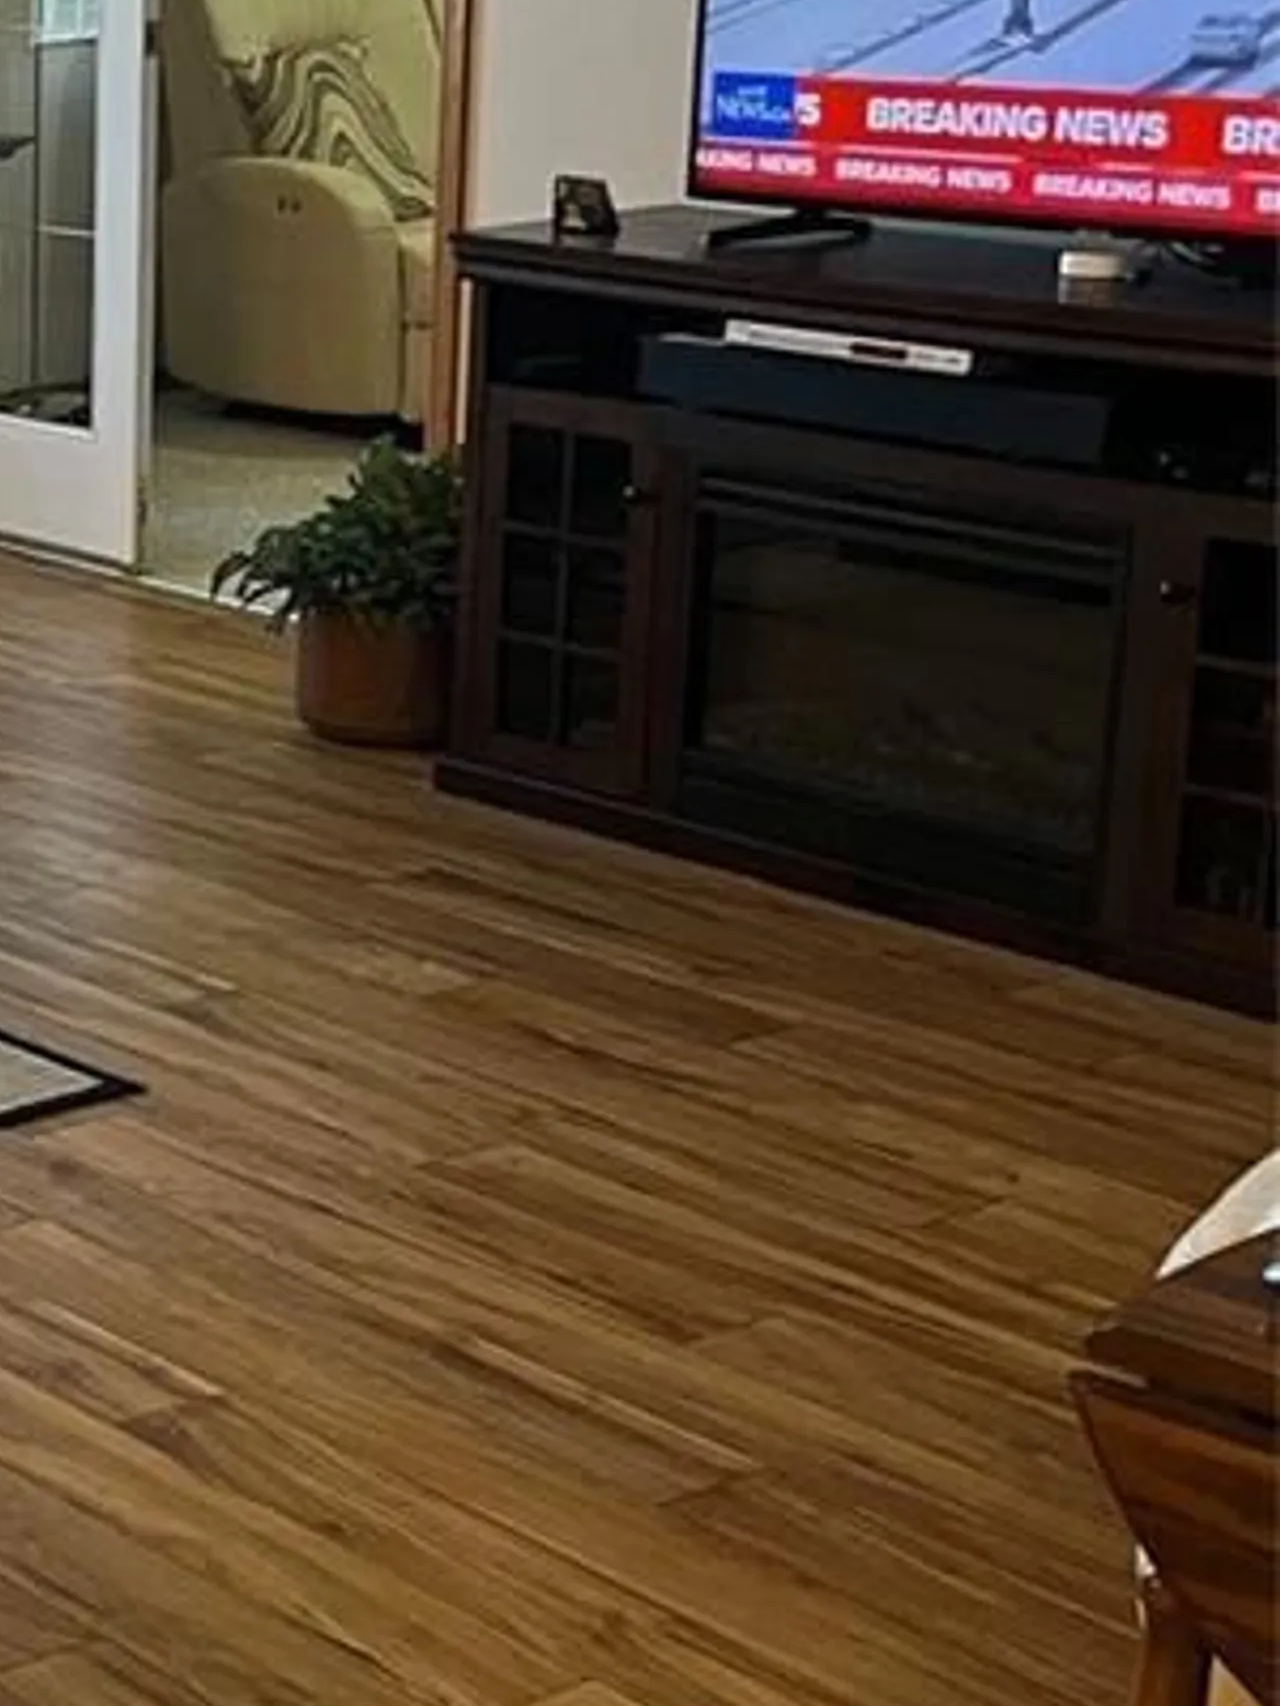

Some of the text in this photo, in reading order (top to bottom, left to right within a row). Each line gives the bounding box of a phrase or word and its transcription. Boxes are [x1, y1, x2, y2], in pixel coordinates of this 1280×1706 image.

[867, 96, 1048, 141] BREAKING
[1053, 105, 1169, 148] NEWS
[836, 158, 1012, 193] BREAKING NEWS
[1033, 174, 1153, 203] BREAKING
[1156, 182, 1230, 209] NEWS
